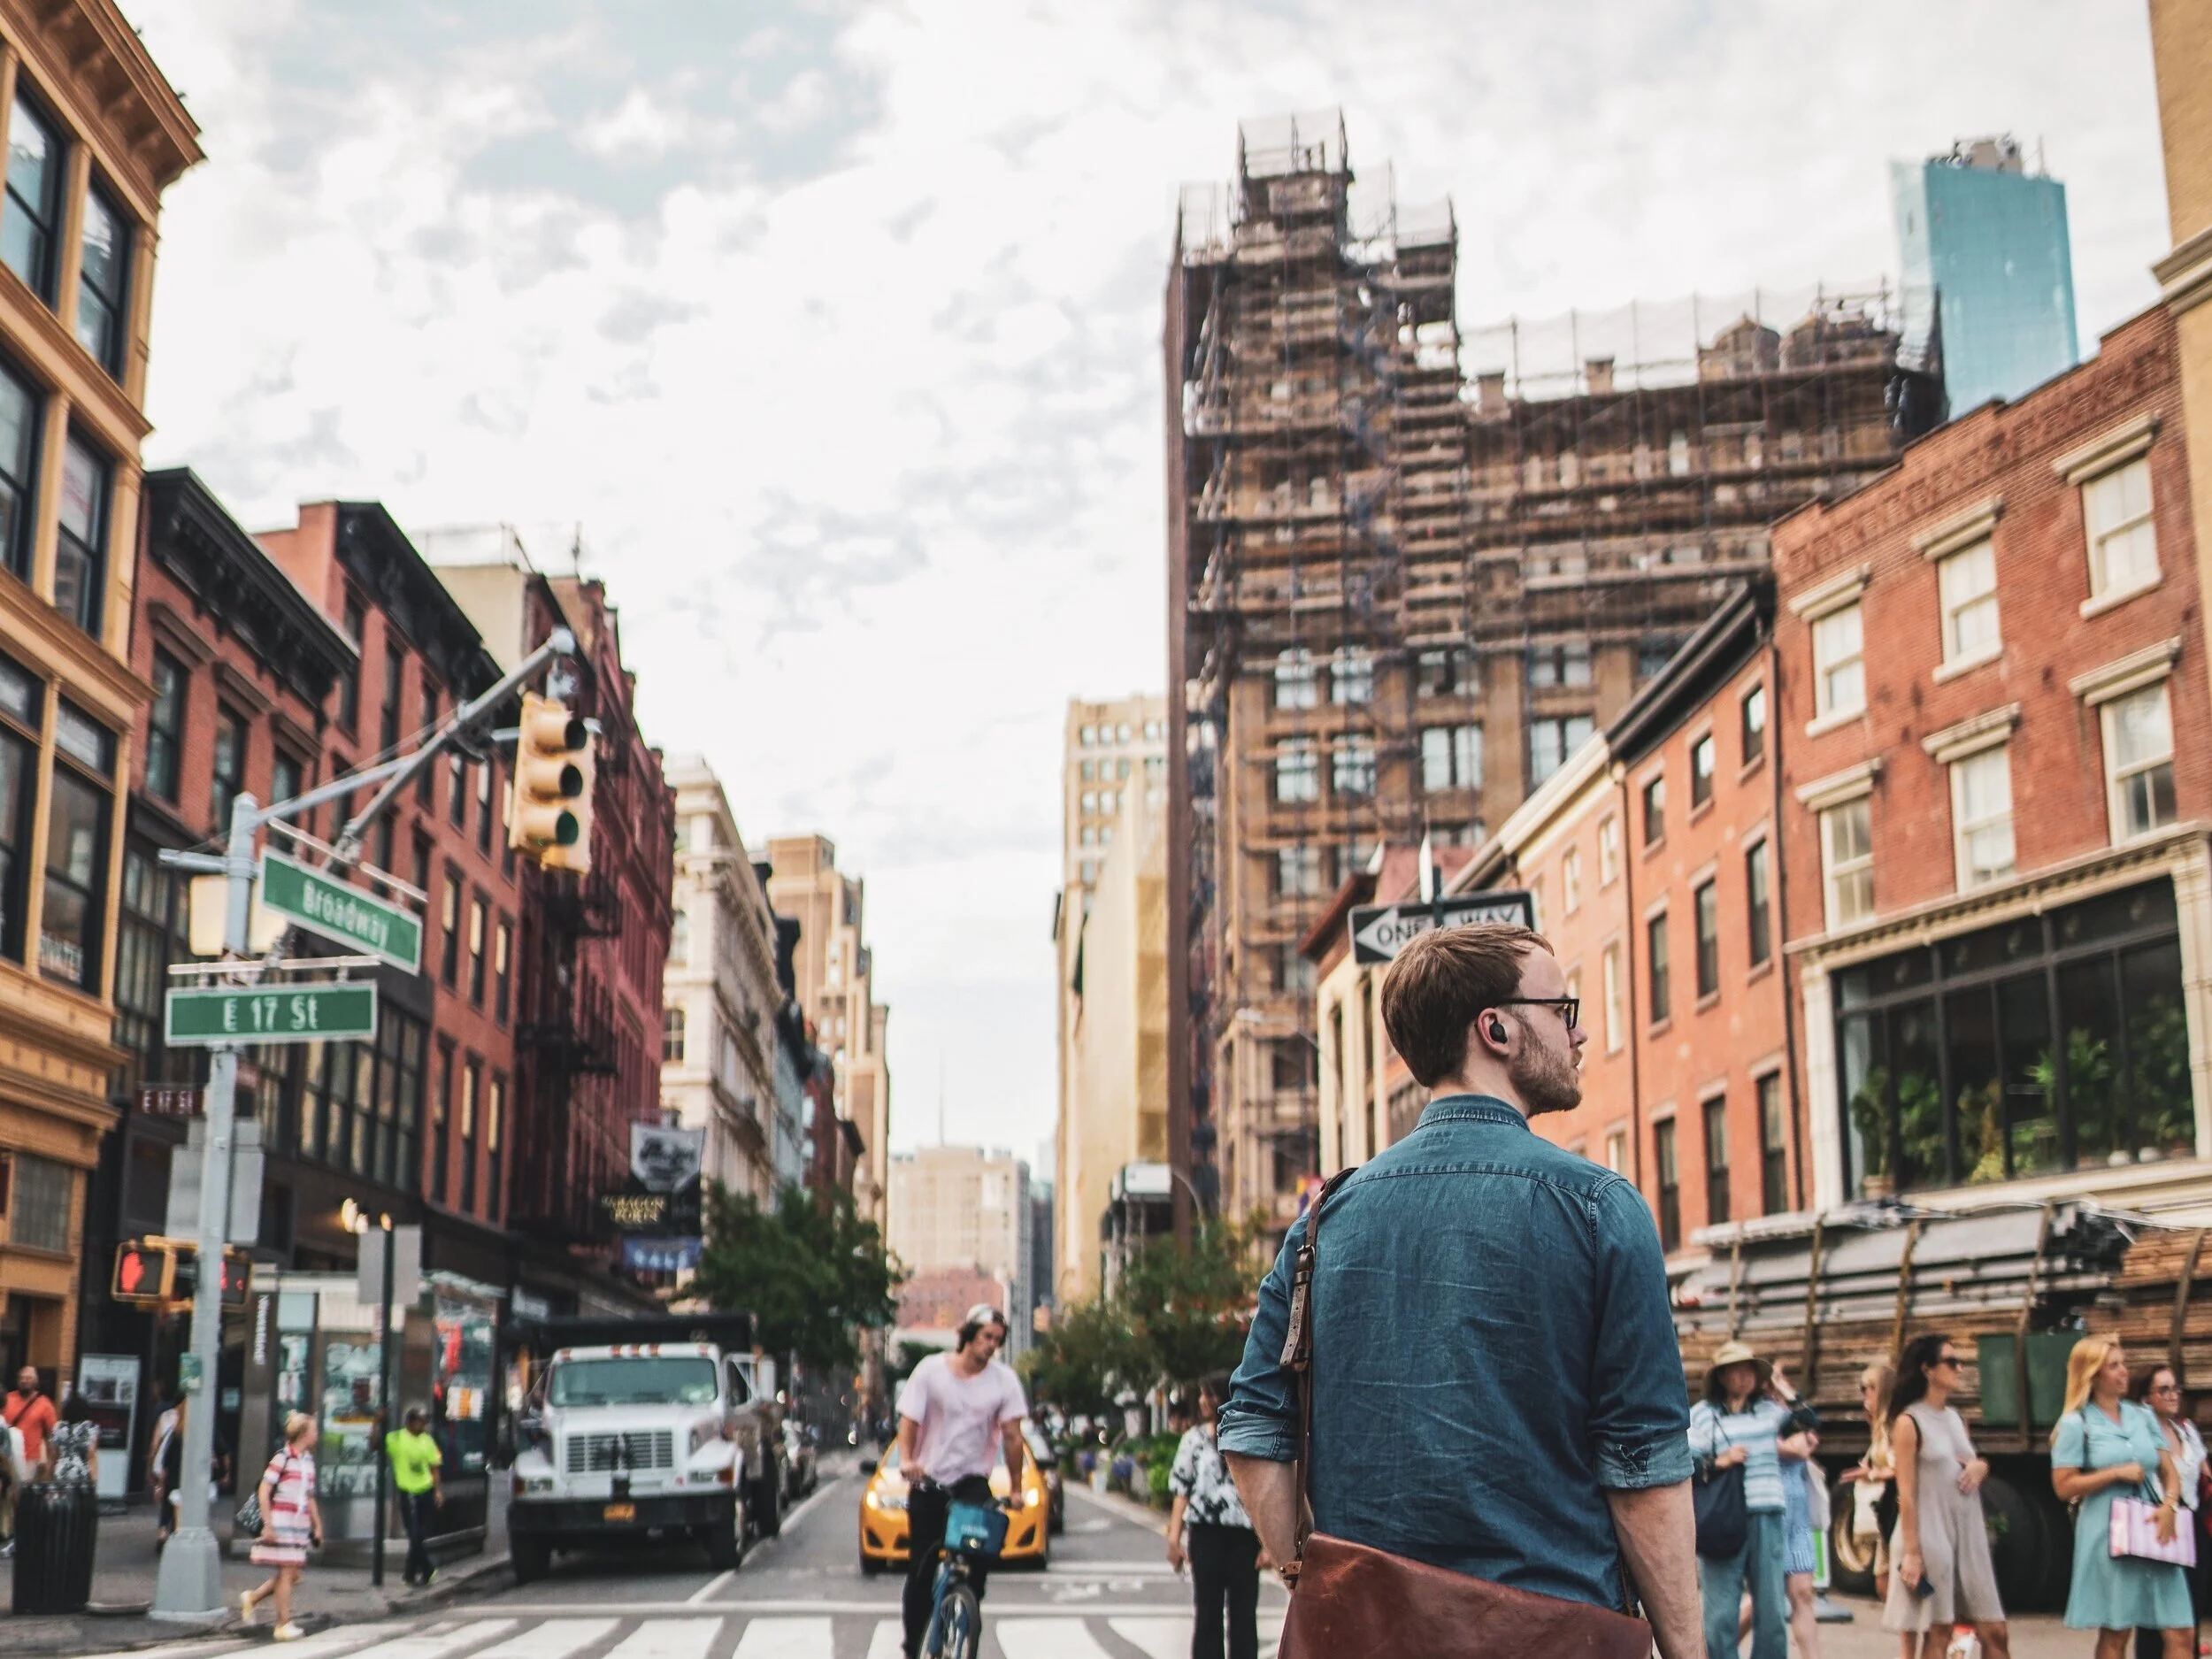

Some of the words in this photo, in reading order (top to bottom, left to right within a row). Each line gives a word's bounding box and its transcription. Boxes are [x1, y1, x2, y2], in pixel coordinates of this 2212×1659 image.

[302, 879, 390, 952] Broadway
[224, 997, 237, 1033] E
[250, 996, 278, 1032] 17
[290, 995, 319, 1030] St
